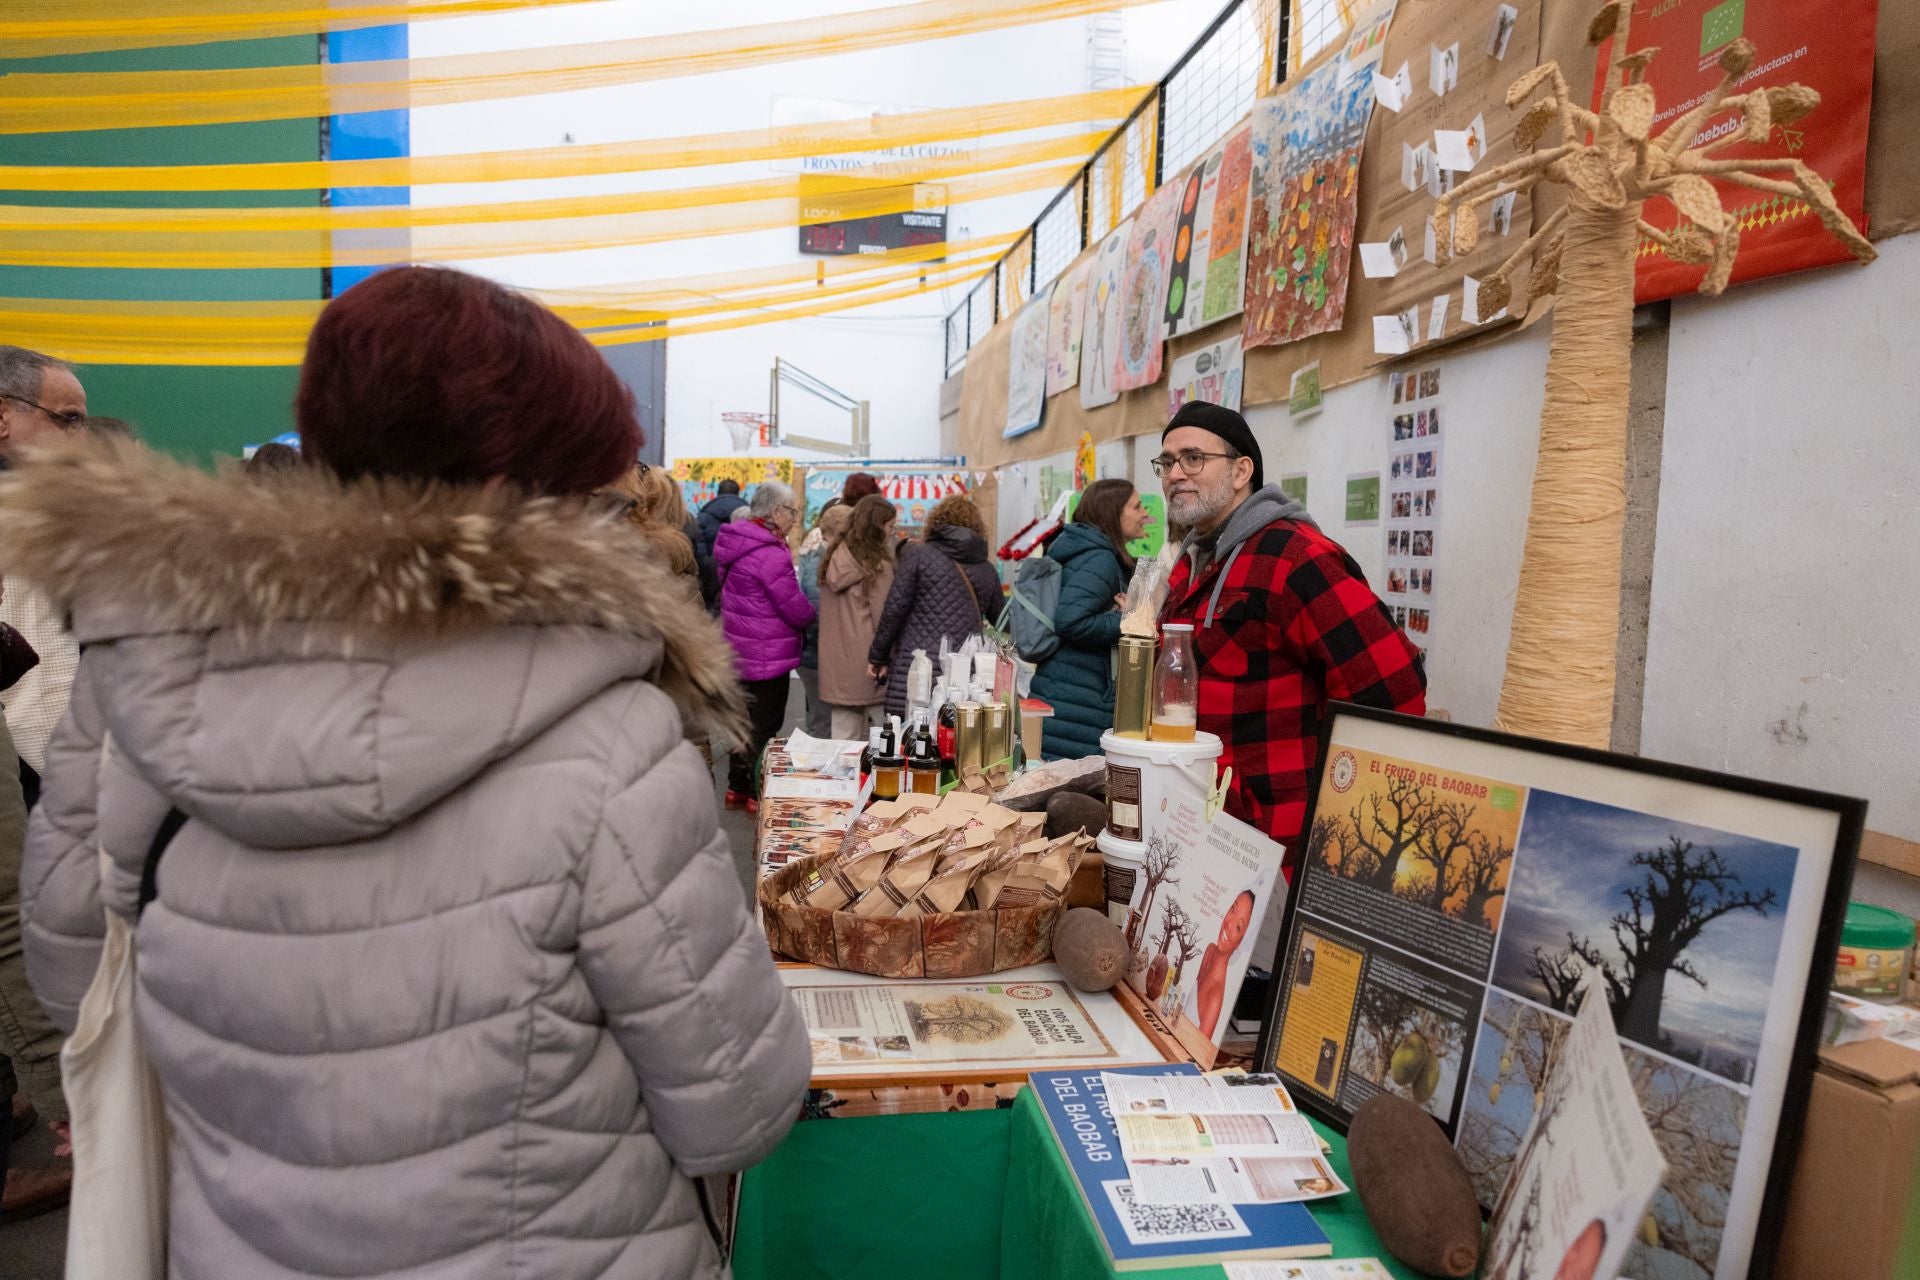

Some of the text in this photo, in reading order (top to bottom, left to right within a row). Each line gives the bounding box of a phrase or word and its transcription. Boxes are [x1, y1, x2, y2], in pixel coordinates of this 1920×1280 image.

[1676, 99, 1695, 113] todo
[1794, 45, 1808, 60] en
[900, 146, 915, 158] LA
[902, 213, 942, 228] VISITANTE
[1370, 760, 1381, 774] EL
[1384, 763, 1416, 784] FRUTO
[1419, 771, 1438, 788] DEL
[1441, 776, 1488, 799] BAOBAB
[1015, 1008, 1033, 1019] DEL
[1022, 1020, 1049, 1046] BAOBAB
[1061, 1024, 1086, 1045] PULPA
[1050, 1077, 1113, 1162] DEL BAOBAB
